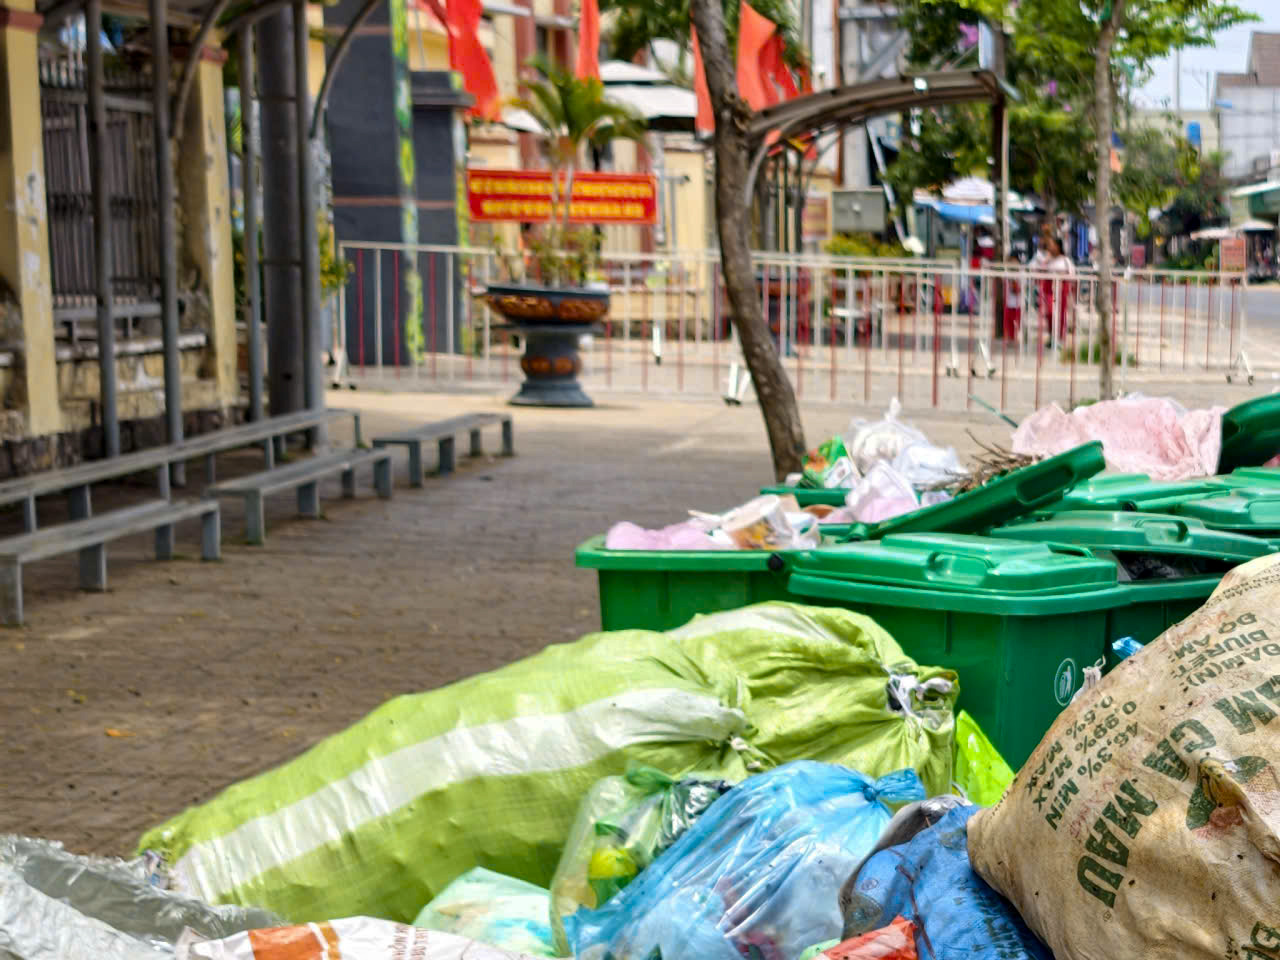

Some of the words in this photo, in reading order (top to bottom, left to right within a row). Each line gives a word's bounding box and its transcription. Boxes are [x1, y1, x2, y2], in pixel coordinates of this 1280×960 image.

[1026, 740, 1063, 795] MAX
[1033, 756, 1072, 812] MAX
[1045, 778, 1080, 831] MIN
[1076, 779, 1158, 909] MAU
